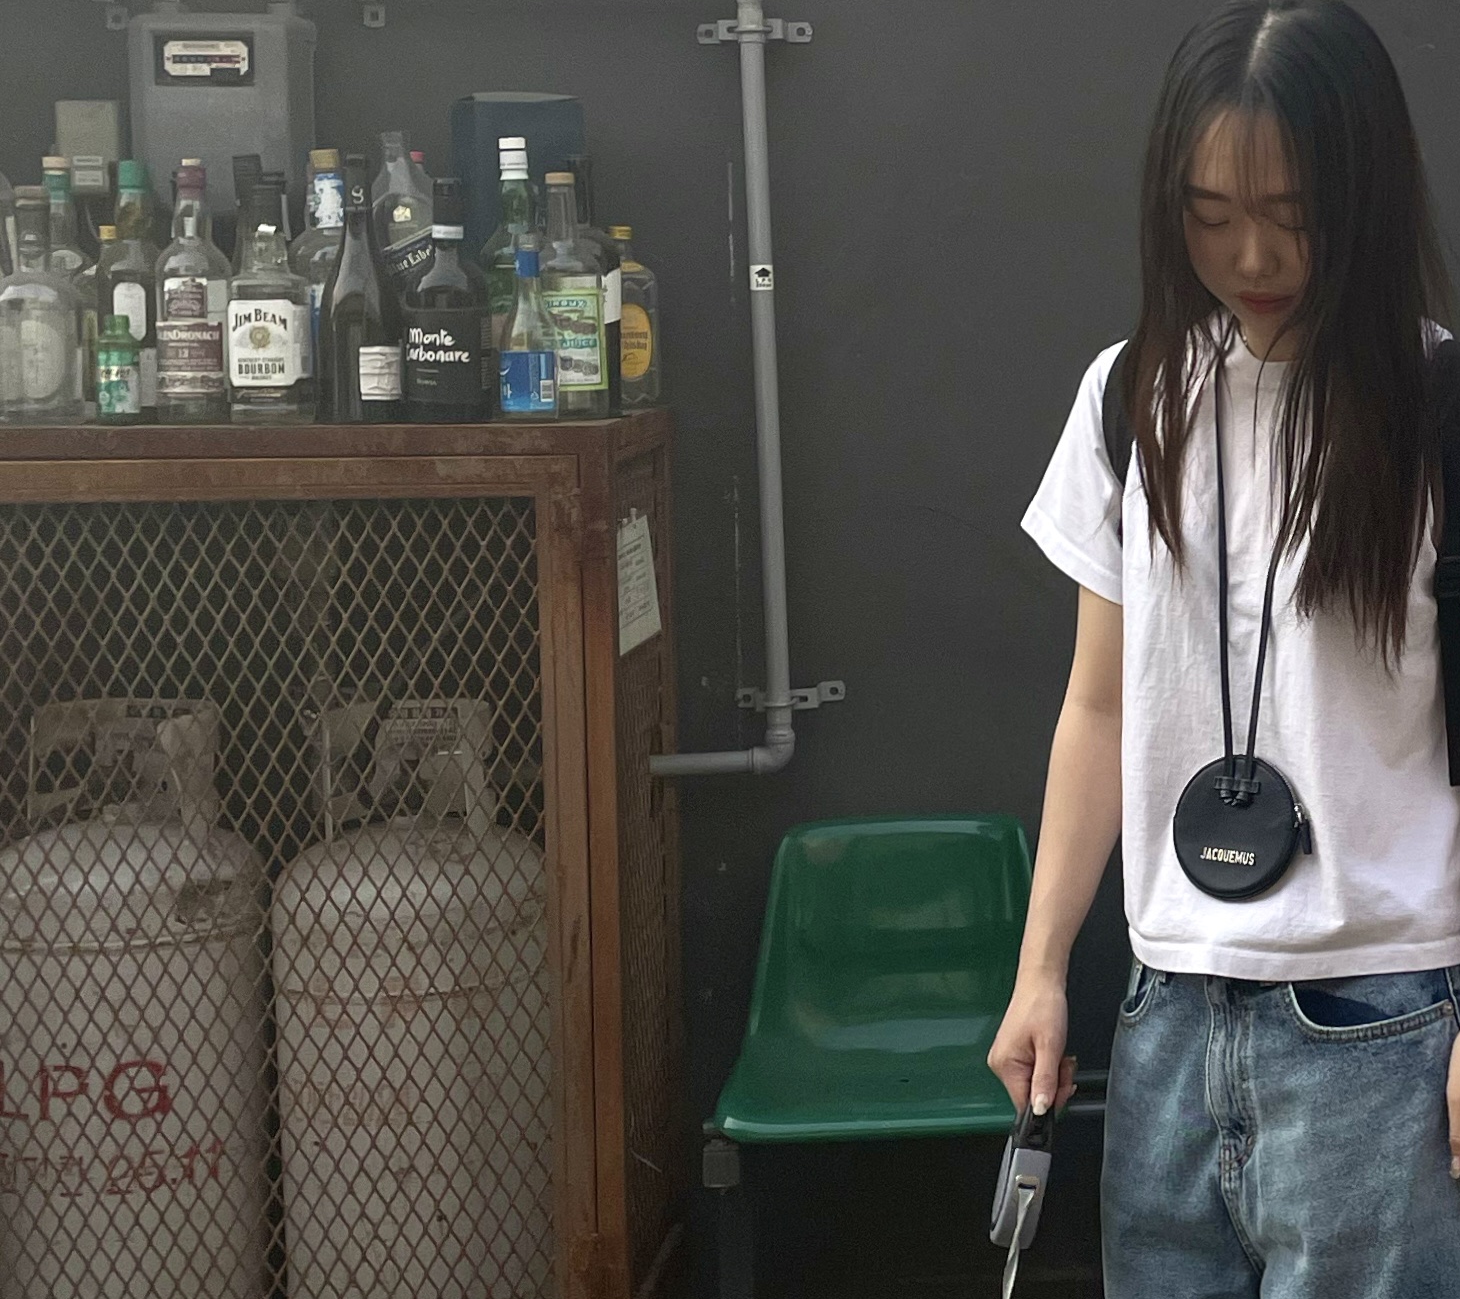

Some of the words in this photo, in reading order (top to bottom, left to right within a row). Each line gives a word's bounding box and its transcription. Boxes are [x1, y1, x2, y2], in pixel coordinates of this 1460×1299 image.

[232, 312, 252, 332] JIM
[254, 308, 288, 332] BEAM
[409, 327, 456, 347] Monte
[238, 362, 286, 375] BOURBON
